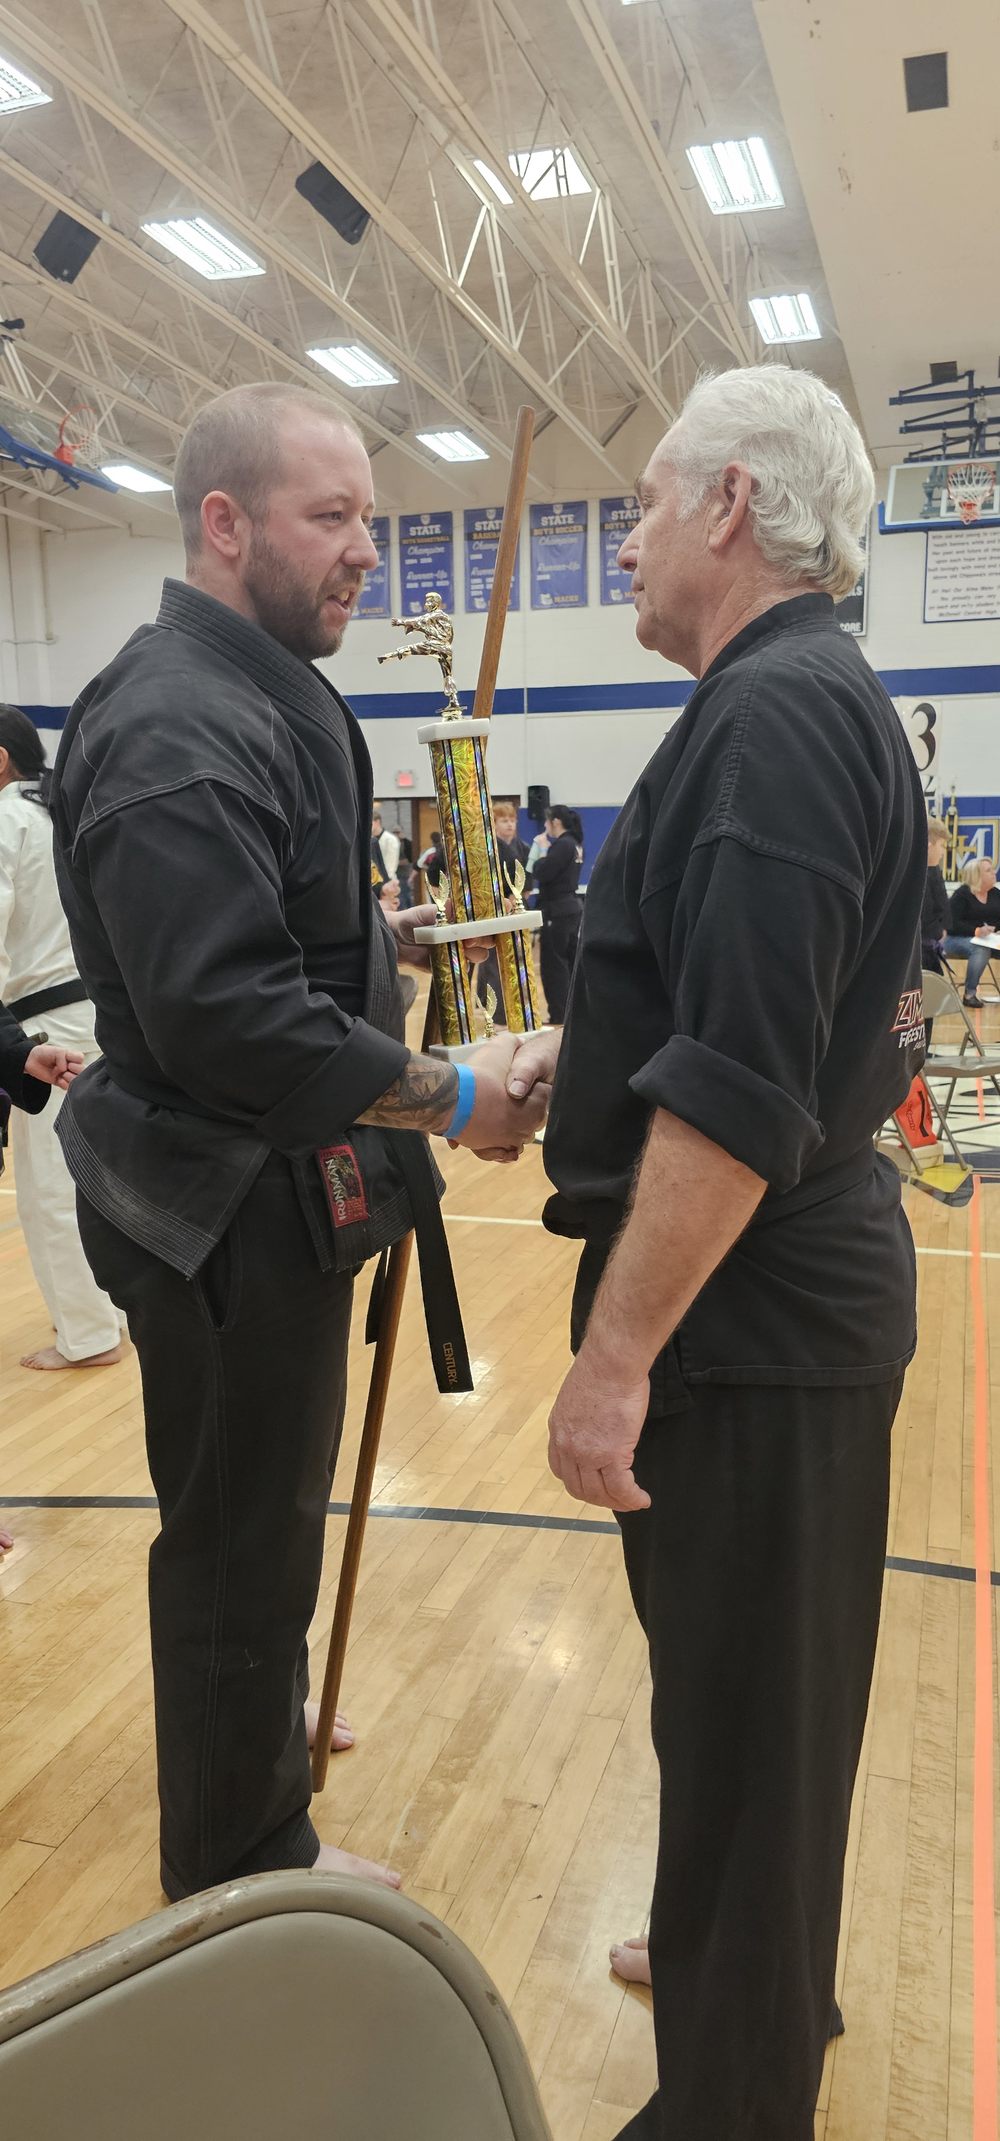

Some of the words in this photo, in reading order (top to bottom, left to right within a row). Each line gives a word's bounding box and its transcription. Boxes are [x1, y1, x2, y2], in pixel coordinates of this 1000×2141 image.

[409, 524, 442, 536] STATE
[474, 520, 503, 531] STAT
[541, 514, 575, 526] STATE
[911, 702, 937, 772] 3
[325, 1158, 348, 1220] IRONMAN
[442, 1342, 458, 1384] CENTURY
